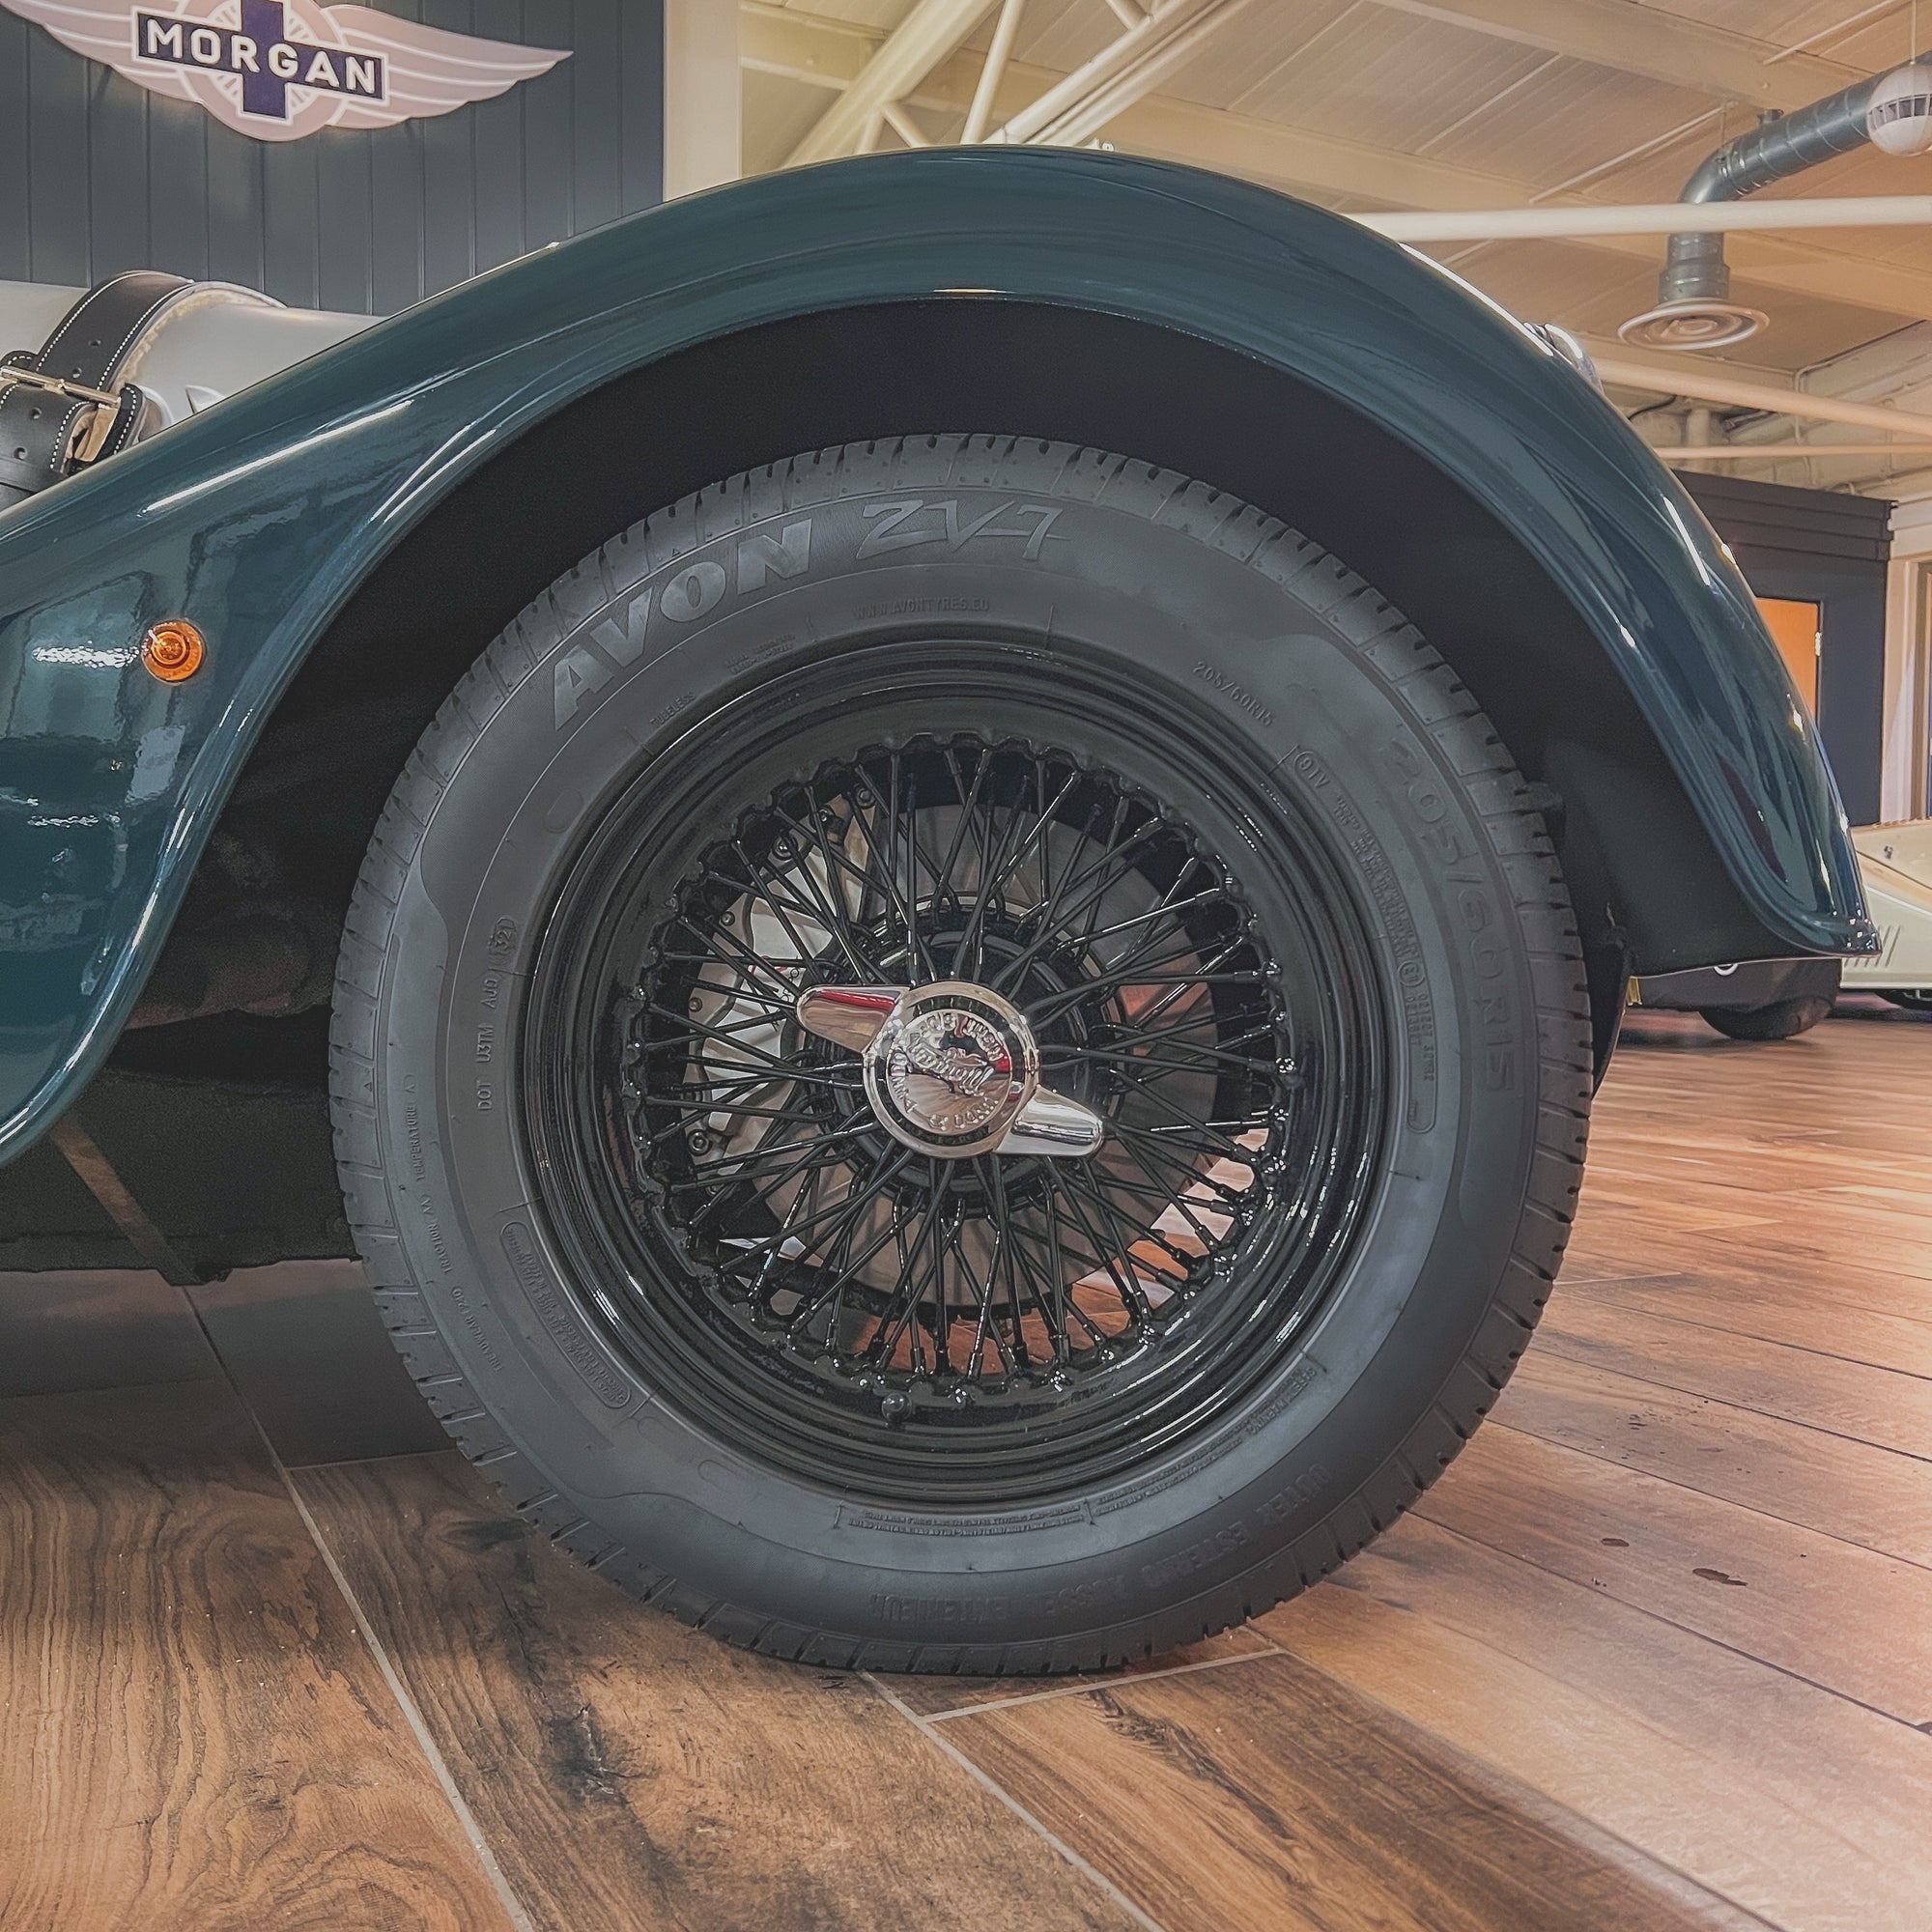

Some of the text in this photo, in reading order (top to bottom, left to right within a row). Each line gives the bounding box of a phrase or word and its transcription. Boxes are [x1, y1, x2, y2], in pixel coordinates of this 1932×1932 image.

[145, 18, 377, 95] MORGAN
[554, 518, 812, 731] AVON
[650, 690, 696, 728] TUBELESS
[476, 1024, 494, 1064] U3TM
[476, 1080, 493, 1111] DOT
[405, 1105, 426, 1181] TEMPERATURE
[427, 1223, 453, 1274] TRACTION
